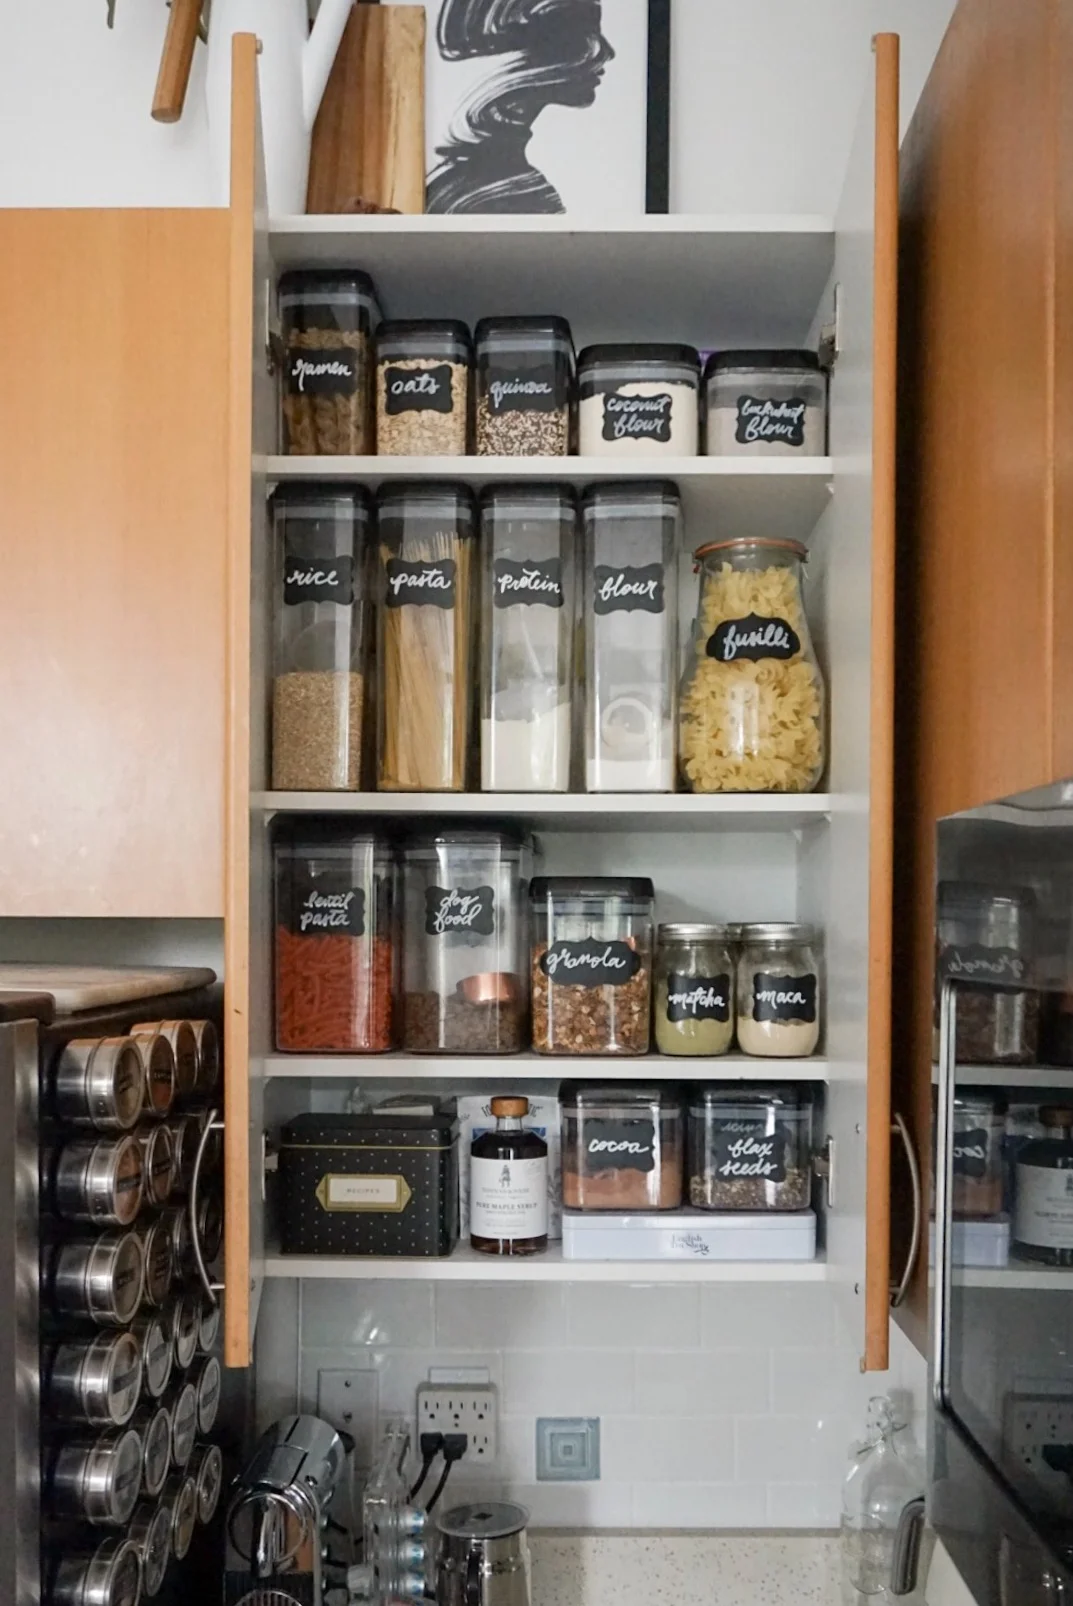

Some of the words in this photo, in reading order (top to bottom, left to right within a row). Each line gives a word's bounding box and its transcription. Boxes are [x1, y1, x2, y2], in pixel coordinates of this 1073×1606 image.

[292, 358, 352, 391] ramen
[391, 373, 440, 395] oats
[490, 378, 552, 408] quinoa
[607, 397, 671, 413] coconut
[614, 414, 664, 438] flour
[745, 416, 794, 441] flour
[287, 567, 339, 585] rice
[390, 568, 451, 595] pasta
[498, 568, 560, 593] protein
[599, 574, 657, 601] flour
[723, 623, 790, 661] fusilli
[304, 891, 355, 910] lentil
[440, 889, 479, 914] dog
[301, 909, 350, 931] pasta
[433, 904, 482, 932] food
[546, 946, 626, 973] granola
[668, 986, 725, 1014] matcha
[757, 989, 806, 1010] maca
[588, 1139, 649, 1153] cocoa
[728, 1137, 774, 1158] flax
[719, 1158, 777, 1176] seeds
[491, 1203, 515, 1211] MAPLE
